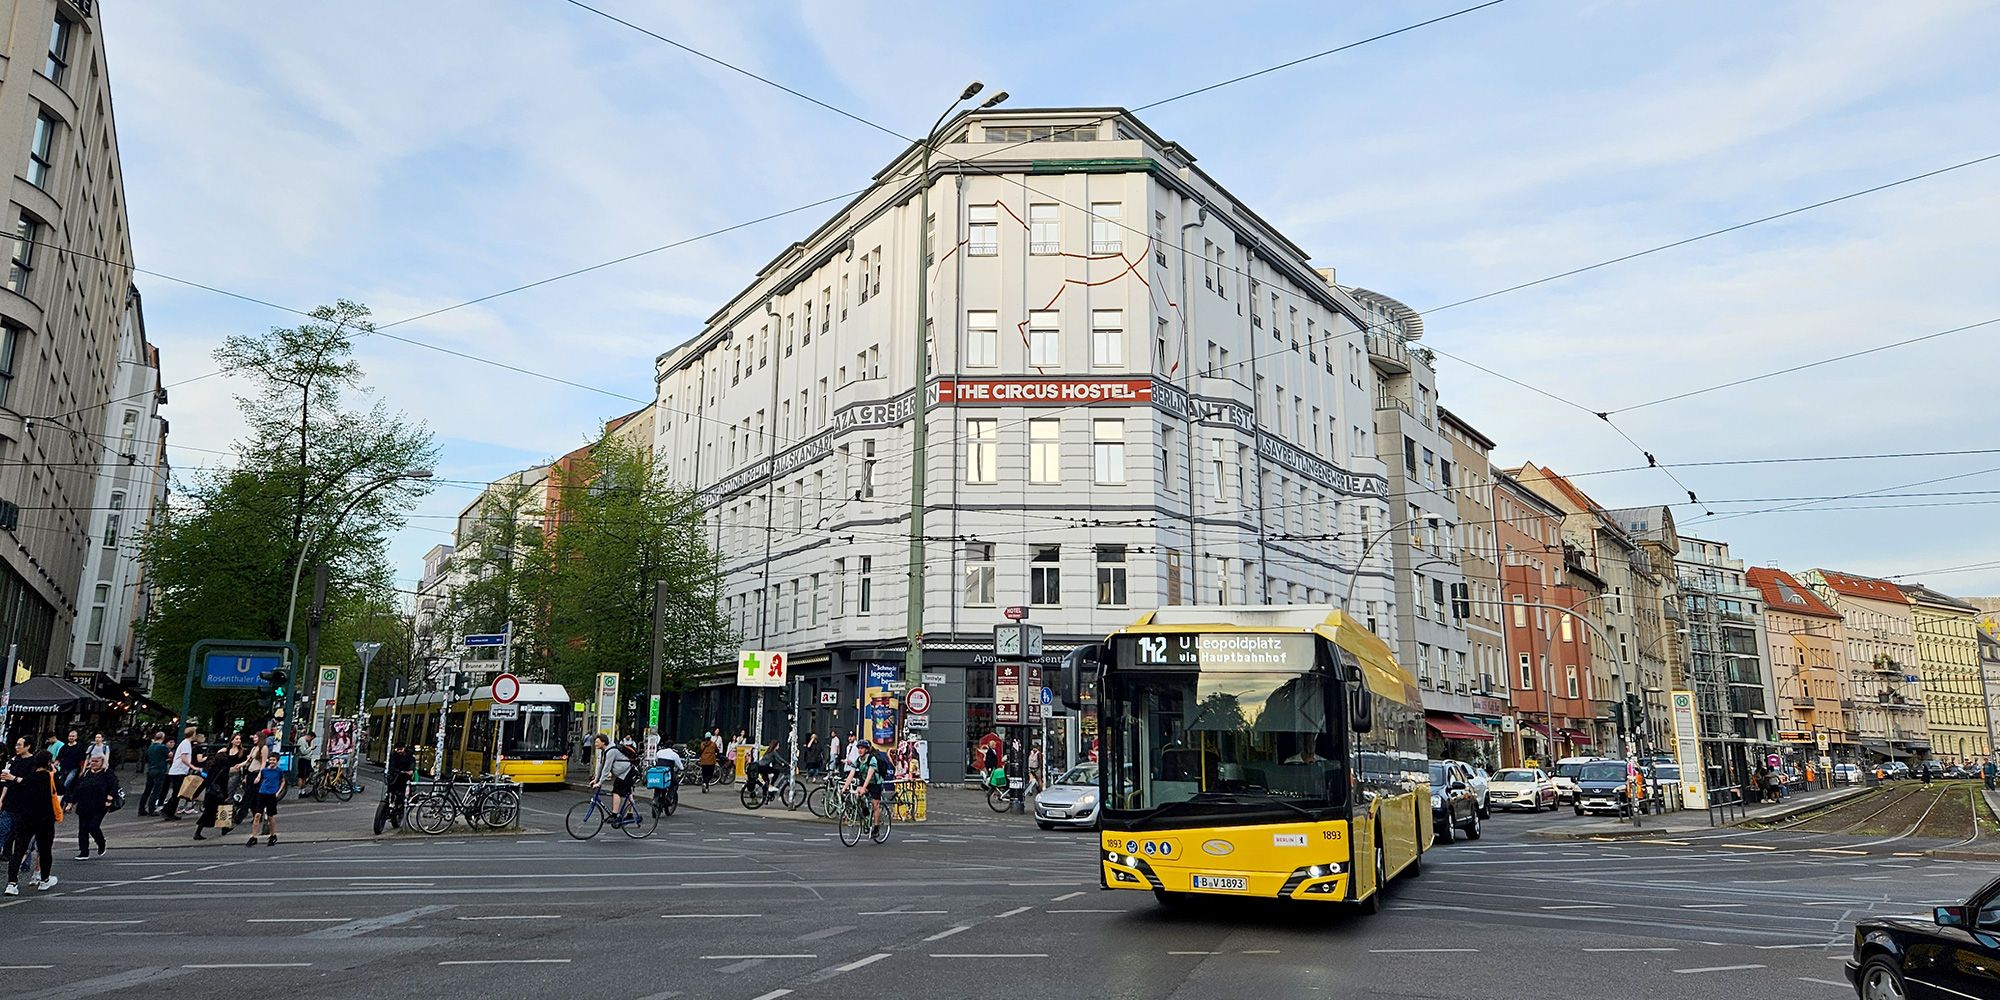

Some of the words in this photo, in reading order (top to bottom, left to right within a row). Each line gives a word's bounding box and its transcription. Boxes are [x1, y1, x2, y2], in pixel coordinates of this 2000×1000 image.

[956, 384, 989, 399] THE
[992, 384, 1058, 399] CIRCUS
[1062, 384, 1135, 398] HOSTEL
[1180, 636, 1190, 649] U
[1195, 636, 1281, 651] Leopoldplatz
[1138, 636, 1167, 663] 142
[1180, 652, 1197, 662] via
[1201, 652, 1287, 663] Hauptbahnhof
[237, 657, 251, 673] U
[207, 674, 254, 683] Rosenthaler
[8, 703, 60, 713] rittenwerk
[1323, 831, 1341, 840] 1893
[1107, 839, 1122, 848] 1893
[1221, 878, 1243, 888] 1893
